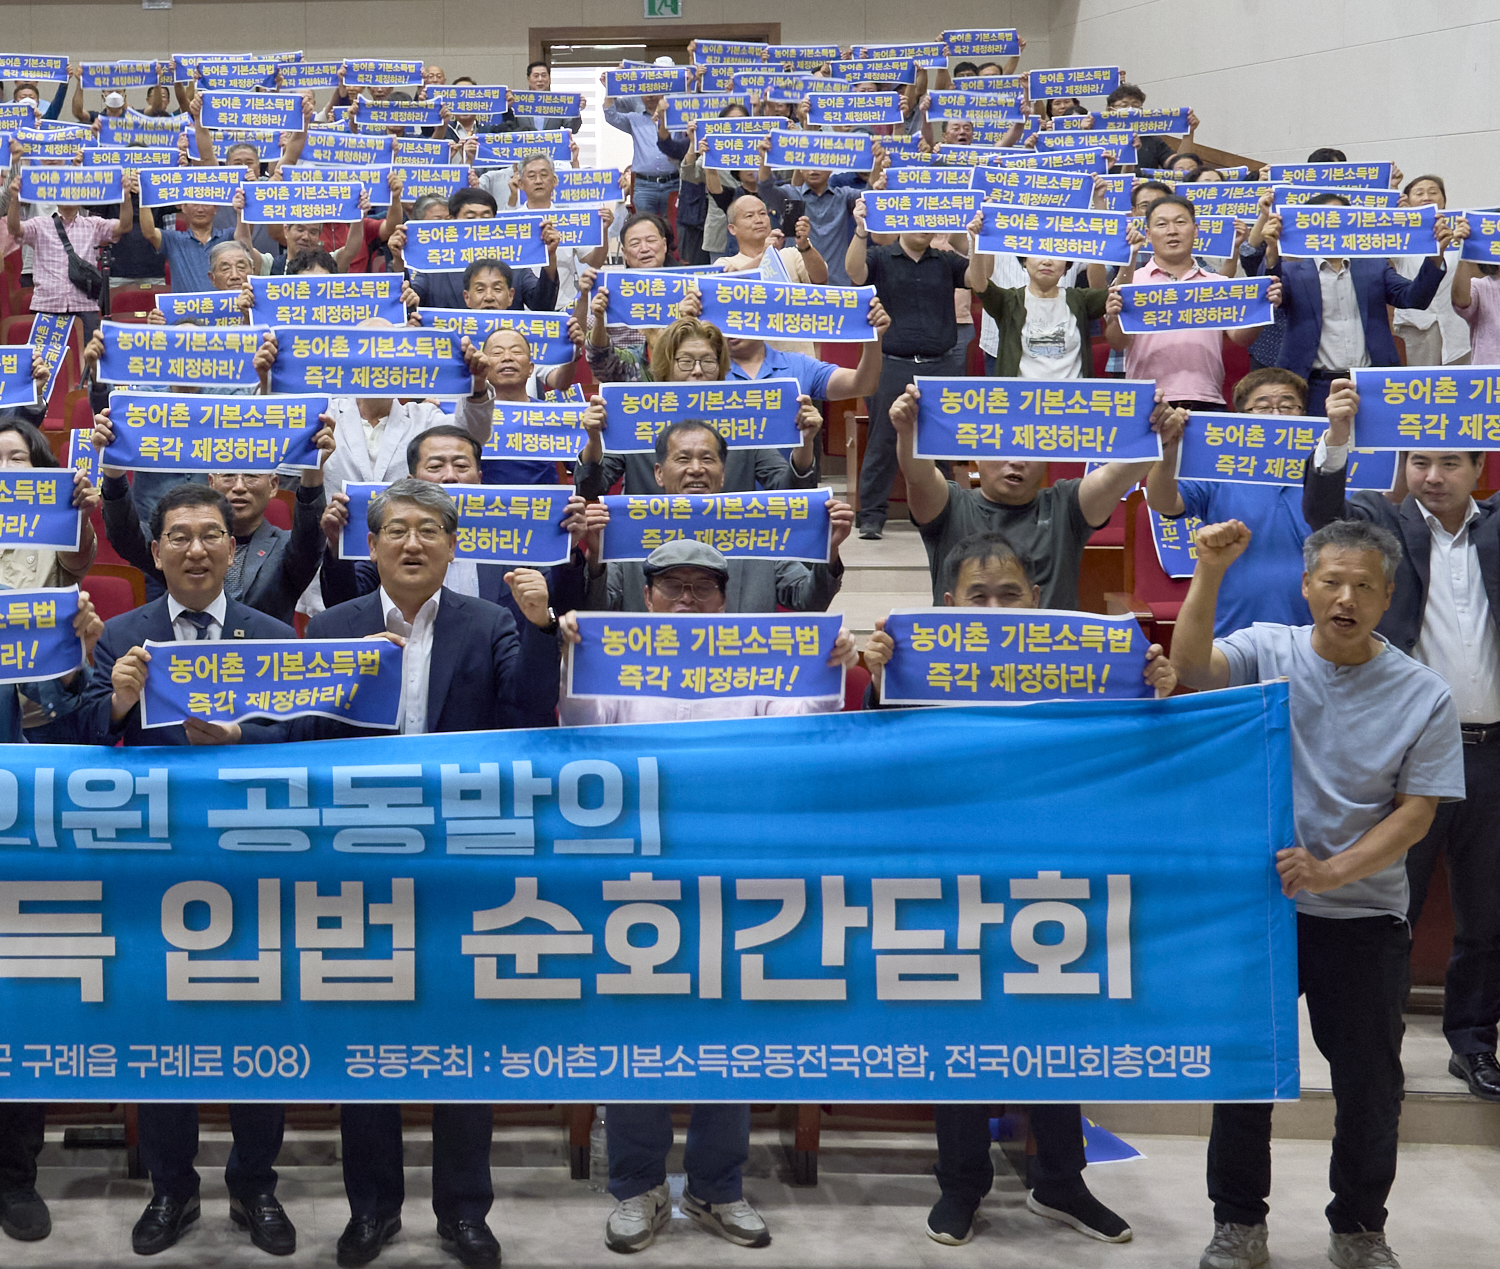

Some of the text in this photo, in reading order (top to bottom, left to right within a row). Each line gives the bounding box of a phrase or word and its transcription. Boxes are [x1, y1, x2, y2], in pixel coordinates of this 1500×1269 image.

[949, 32, 1013, 43] 농어촌 기본소득법
[954, 45, 1007, 54] 즉각 제정하라!
[24, 58, 61, 68] 기본소득법
[3, 69, 56, 79] 즉각 제정하라!
[615, 70, 678, 81] 농어촌 기본소득법
[1039, 70, 1111, 84] 농어촌 기본소득법
[620, 82, 674, 92] 즉각 제정하라!
[1045, 84, 1105, 95] 즉각 제정하라!
[818, 96, 893, 108] 농어촌 기본소득법
[824, 111, 885, 121] 즉각 제정하라!
[30, 171, 114, 184] 농어촌 기본소득법
[151, 172, 239, 185] 농어촌 기본소득법
[36, 187, 106, 200] 즉각 제정하라!
[158, 186, 232, 200] 즉각 제정하라!
[255, 186, 351, 201] 농어촌 기본소득법
[876, 195, 975, 211] 농어촌 기본소득법
[263, 204, 343, 218] 즉각 제정하라!
[885, 213, 967, 229] 즉각 제정하라!
[1296, 210, 1422, 229] 농어촌 기본소득법
[995, 212, 1118, 236] 농어촌 기본소득법
[1003, 234, 1106, 256] 즉각 제정하라!
[1305, 233, 1411, 250] 즉각 제정하라!
[716, 283, 858, 308] 농어촌 기본소득법
[1133, 284, 1259, 307] 농어촌 기본소득법
[726, 310, 845, 334] 즉각 제정하라!
[1143, 306, 1246, 326] 즉각 제정하라!
[292, 335, 452, 359] 농어촌 기본소득법
[304, 366, 439, 388] 즉각 제정하라!
[940, 387, 1136, 417] 농어촌 기본소득법
[125, 403, 307, 429] 농어촌 기본소득법
[955, 423, 1118, 453] 즉각 제정하라!
[138, 437, 290, 463] 즉각 제정하라!
[601, 624, 820, 656] 농어촌 기본소득법
[910, 622, 1131, 653] 농어촌 기본소득법
[168, 649, 380, 684] 농어촌 기본소득법
[618, 665, 800, 693] 즉각 제정하라!
[926, 662, 1111, 694] 즉각 제정하라!
[187, 683, 359, 716] 즉각 제정하라!
[207, 756, 662, 855] 공동발의
[161, 877, 416, 1001] 입법
[461, 871, 1132, 1001] 순회간담회
[21, 1044, 118, 1078] 구례읍
[127, 1044, 224, 1078] 구례로
[232, 1044, 311, 1079] 508)
[344, 1044, 473, 1079] 공동주최
[500, 1043, 935, 1081] 농어촌기본소득운동전국연합,
[945, 1043, 1211, 1078] 전국어민회총연맹
